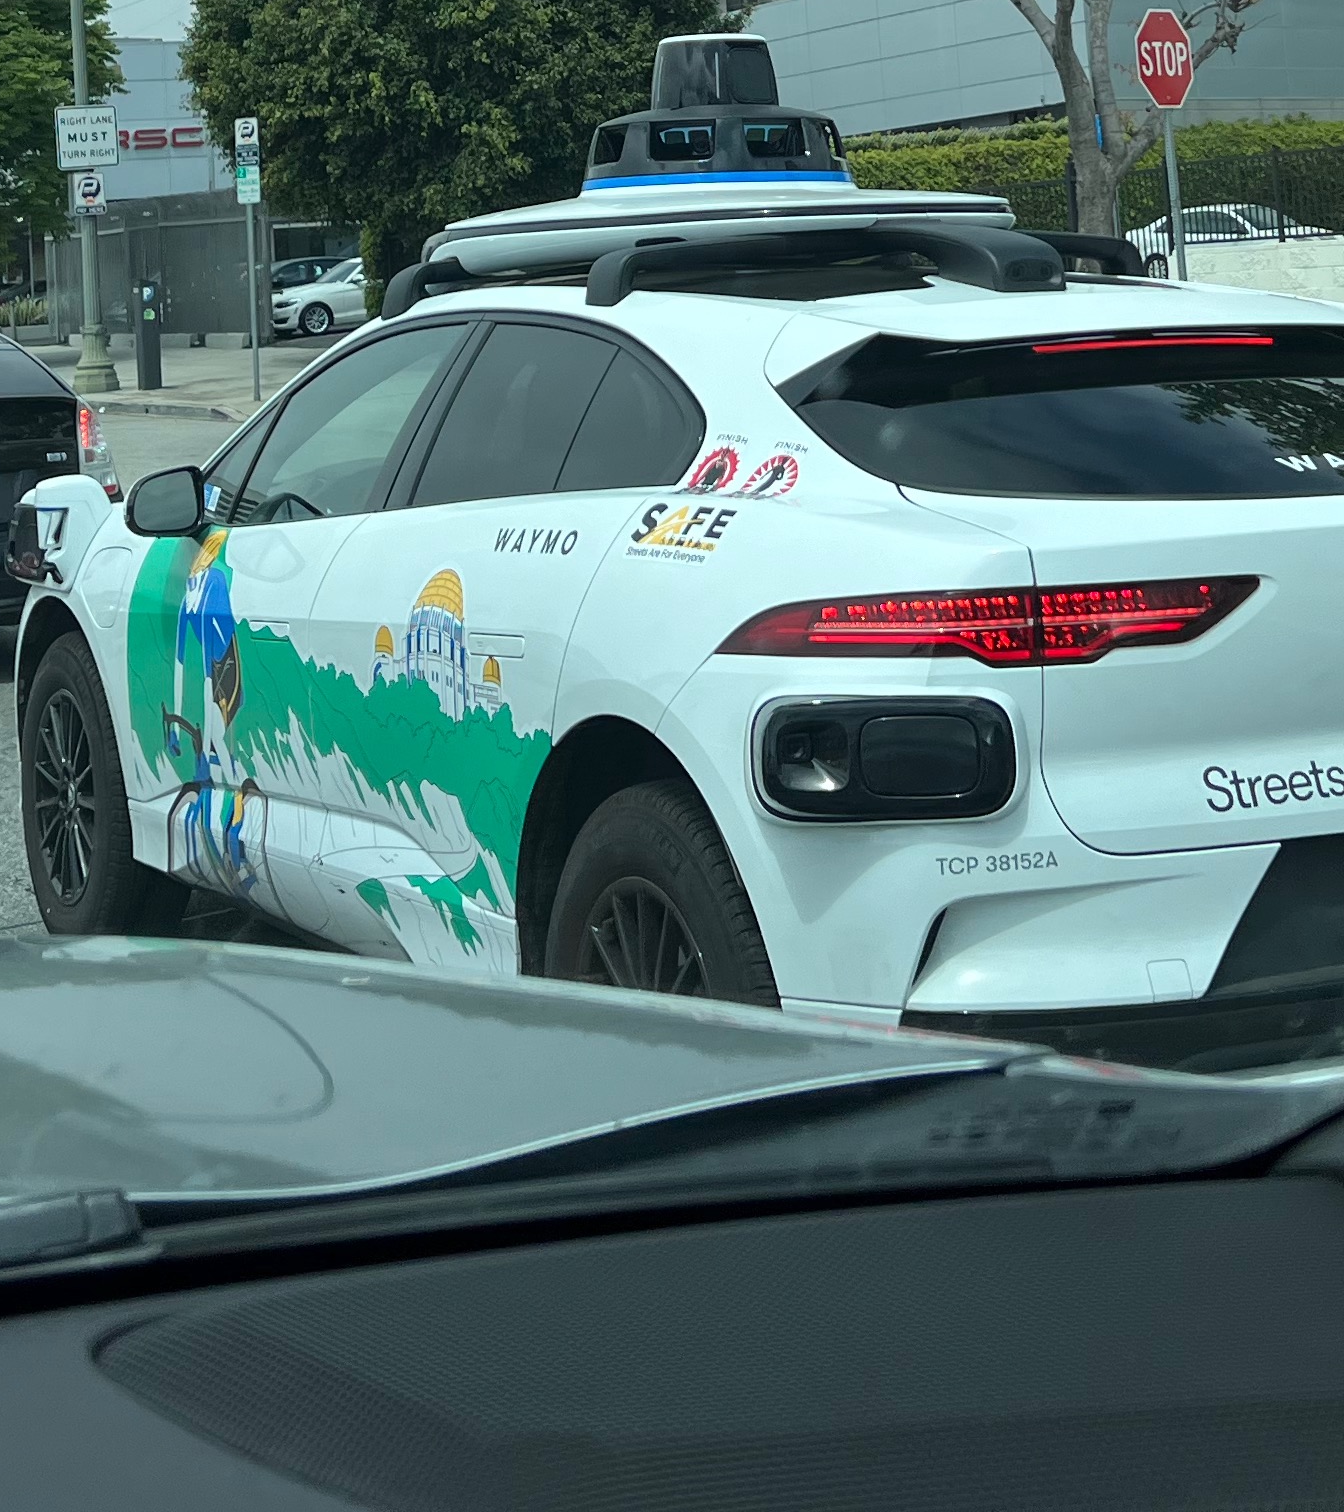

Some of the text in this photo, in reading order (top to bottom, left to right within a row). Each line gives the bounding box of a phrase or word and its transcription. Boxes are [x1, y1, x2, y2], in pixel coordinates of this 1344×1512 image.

[1140, 40, 1188, 77] STOP
[60, 115, 113, 126] RIGHT LANE
[67, 131, 108, 143] MUST
[62, 148, 115, 159] TURN RIGHT
[716, 434, 749, 445] FINISH
[774, 441, 809, 454] FINISH
[631, 502, 738, 544] SAFE
[493, 528, 579, 555] WAYMO
[936, 850, 1058, 876] TCP 38152A
